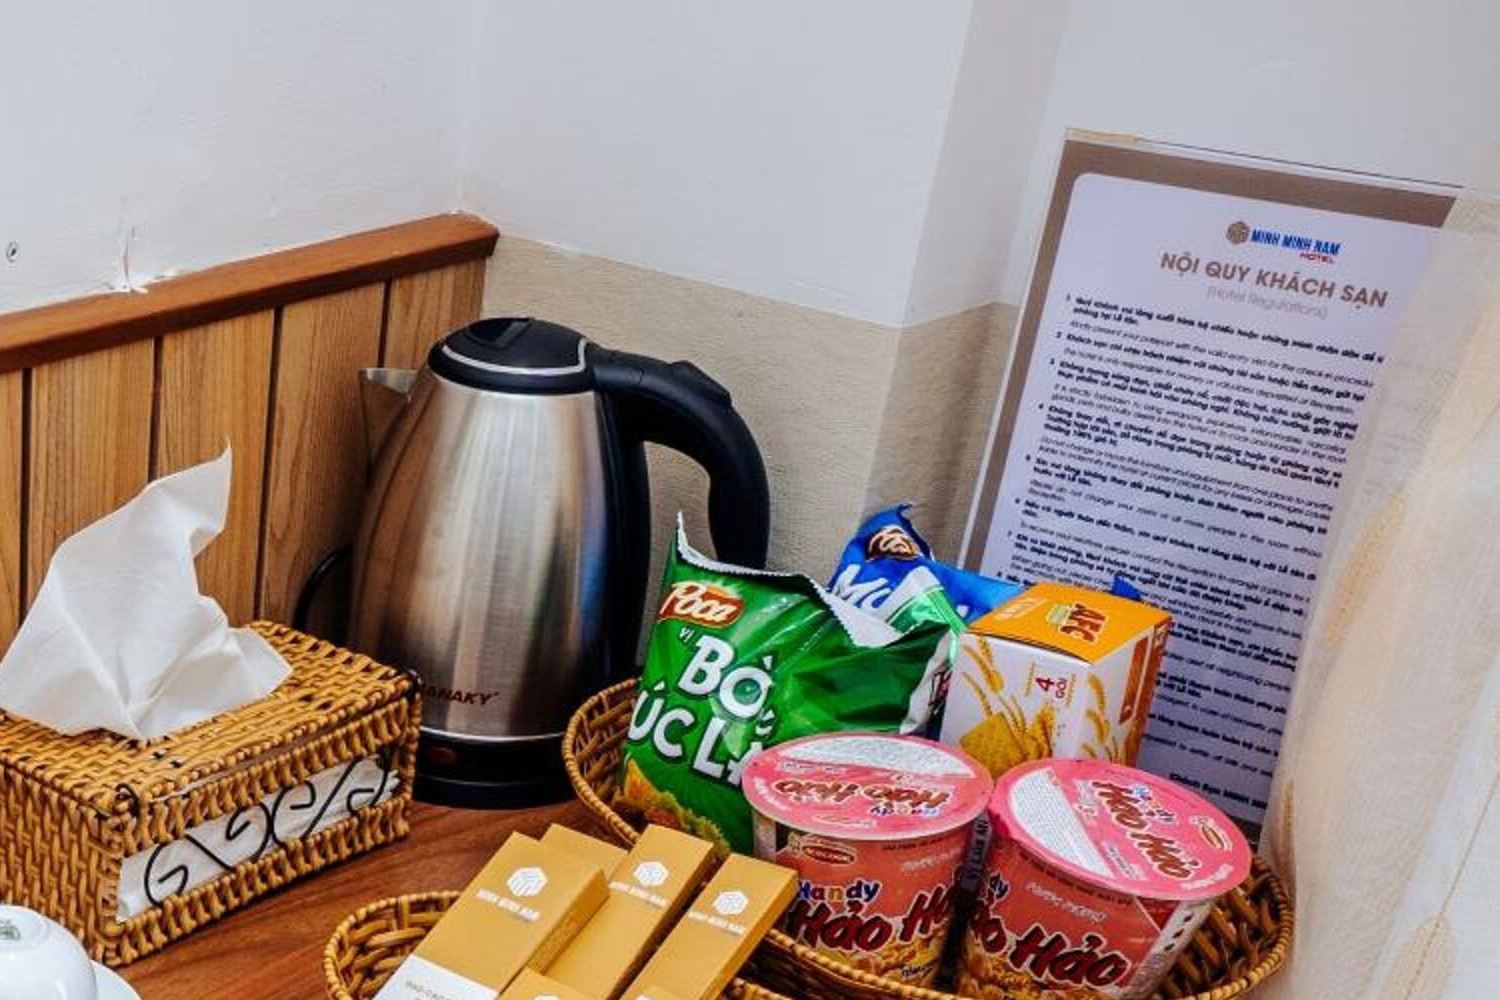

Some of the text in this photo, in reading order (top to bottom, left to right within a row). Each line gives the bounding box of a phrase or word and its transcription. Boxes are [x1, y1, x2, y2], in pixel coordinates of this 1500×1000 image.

[1251, 229, 1340, 256] MINH MINH NAM
[1160, 252, 1388, 309] NỘI QUY KHÁCH SẠN
[1035, 677, 1054, 691] 4
[786, 898, 893, 951] Hảo
[1009, 923, 1132, 987] Hảo
